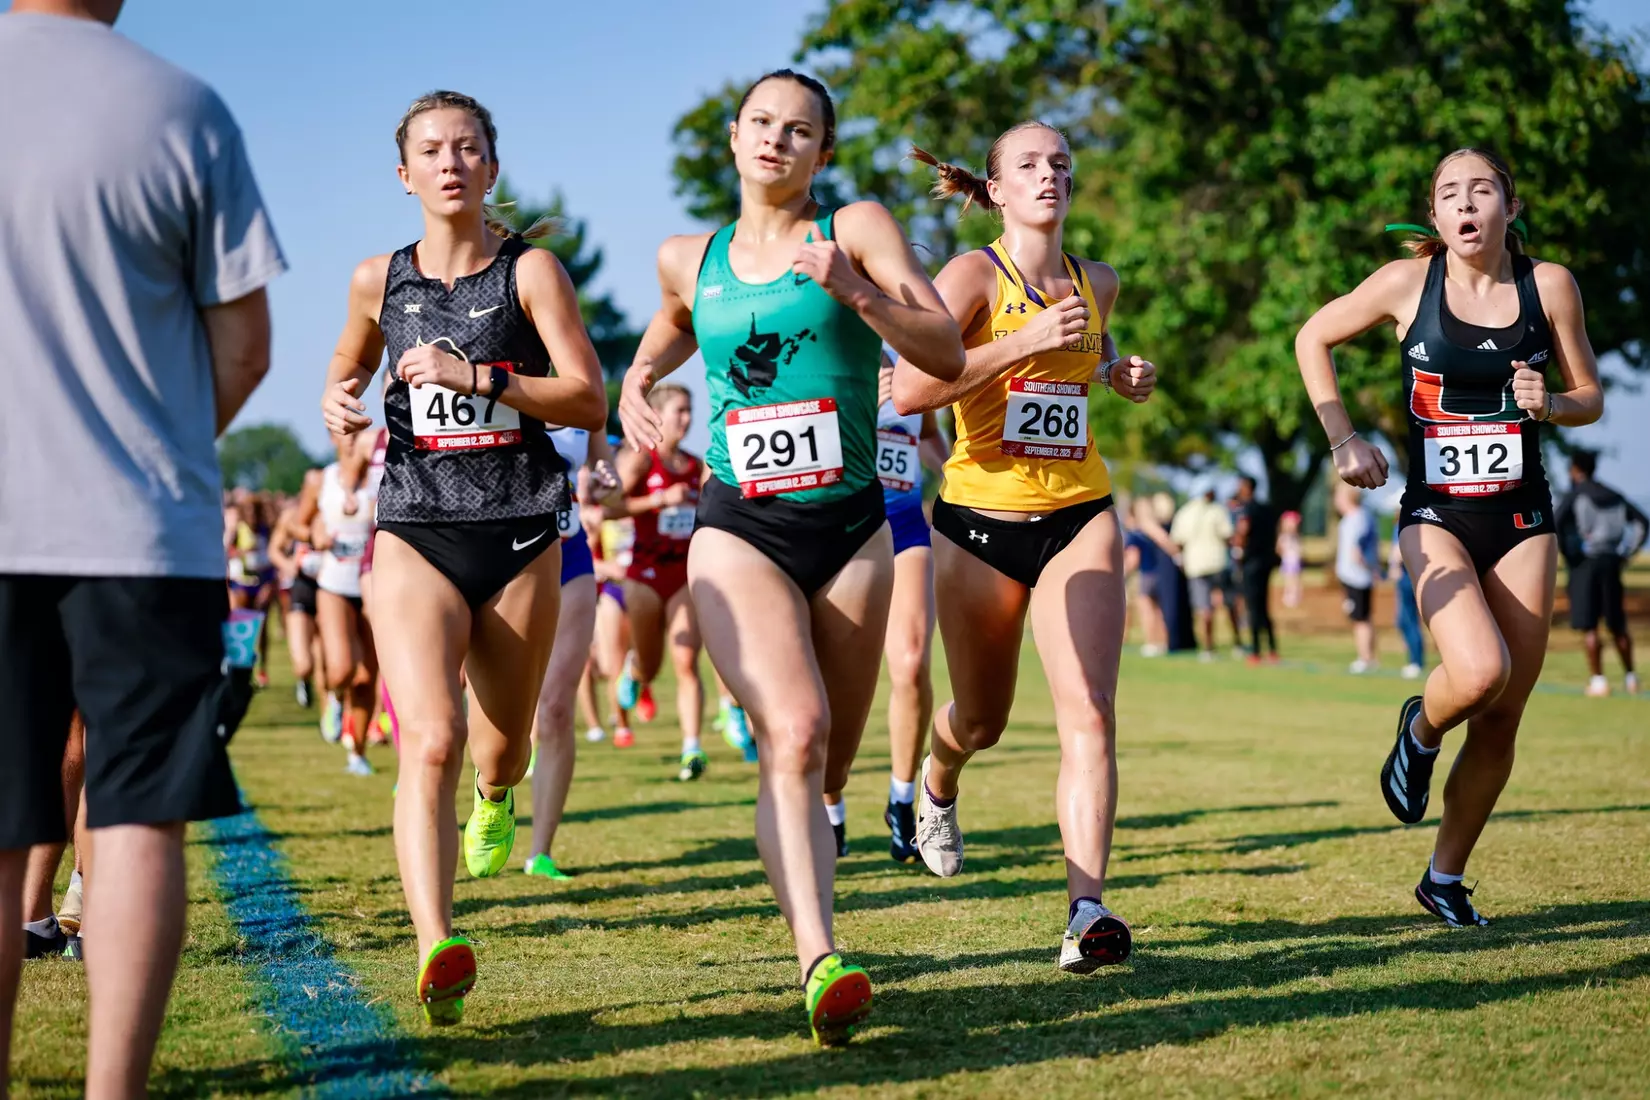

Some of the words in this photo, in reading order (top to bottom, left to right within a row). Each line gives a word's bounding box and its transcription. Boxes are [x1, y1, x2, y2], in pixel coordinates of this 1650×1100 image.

[1408, 350, 1430, 362] adidas
[1529, 349, 1549, 362] ACC
[1024, 381, 1057, 393] SOUTHERN
[1057, 384, 1081, 395] SHOWCASE
[427, 390, 497, 427] 467
[738, 407, 777, 424] SOUTHERN
[777, 402, 821, 418] SHOWCASE
[1018, 402, 1079, 439] 268
[1437, 426, 1470, 436] SOUTHERN
[1472, 424, 1508, 435] SHOWCASE
[437, 437, 471, 448] SEPTEMBER
[479, 435, 495, 446] 2025
[743, 426, 819, 471] 291
[1024, 445, 1053, 456] SEPTEMBER
[1060, 448, 1071, 457] 2025
[1439, 443, 1509, 476] 312
[756, 479, 792, 493] SEPTEMBER
[800, 474, 818, 486] 2025
[1449, 484, 1479, 494] SEPTEMBER
[1486, 483, 1500, 493] 2025
[1513, 510, 1542, 529] U
